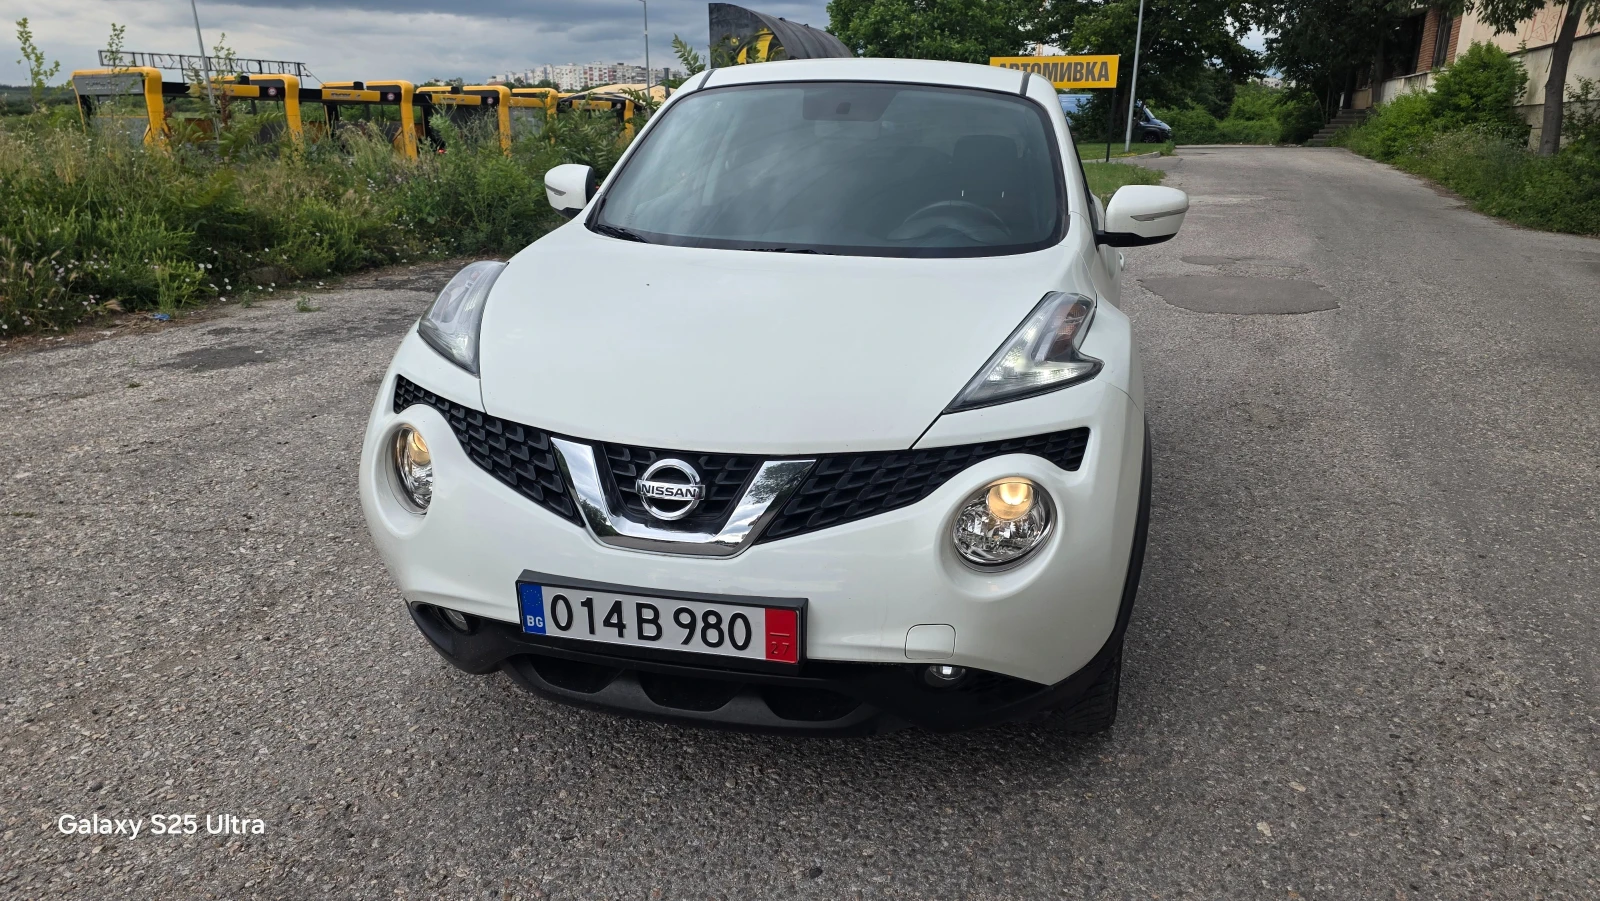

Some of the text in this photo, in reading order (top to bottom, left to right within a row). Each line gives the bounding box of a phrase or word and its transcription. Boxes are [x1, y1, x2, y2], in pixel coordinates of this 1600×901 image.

[999, 61, 1110, 82] ТОМИВКА
[641, 483, 697, 498] NISSAN
[526, 615, 544, 628] BG
[771, 641, 790, 656] 27
